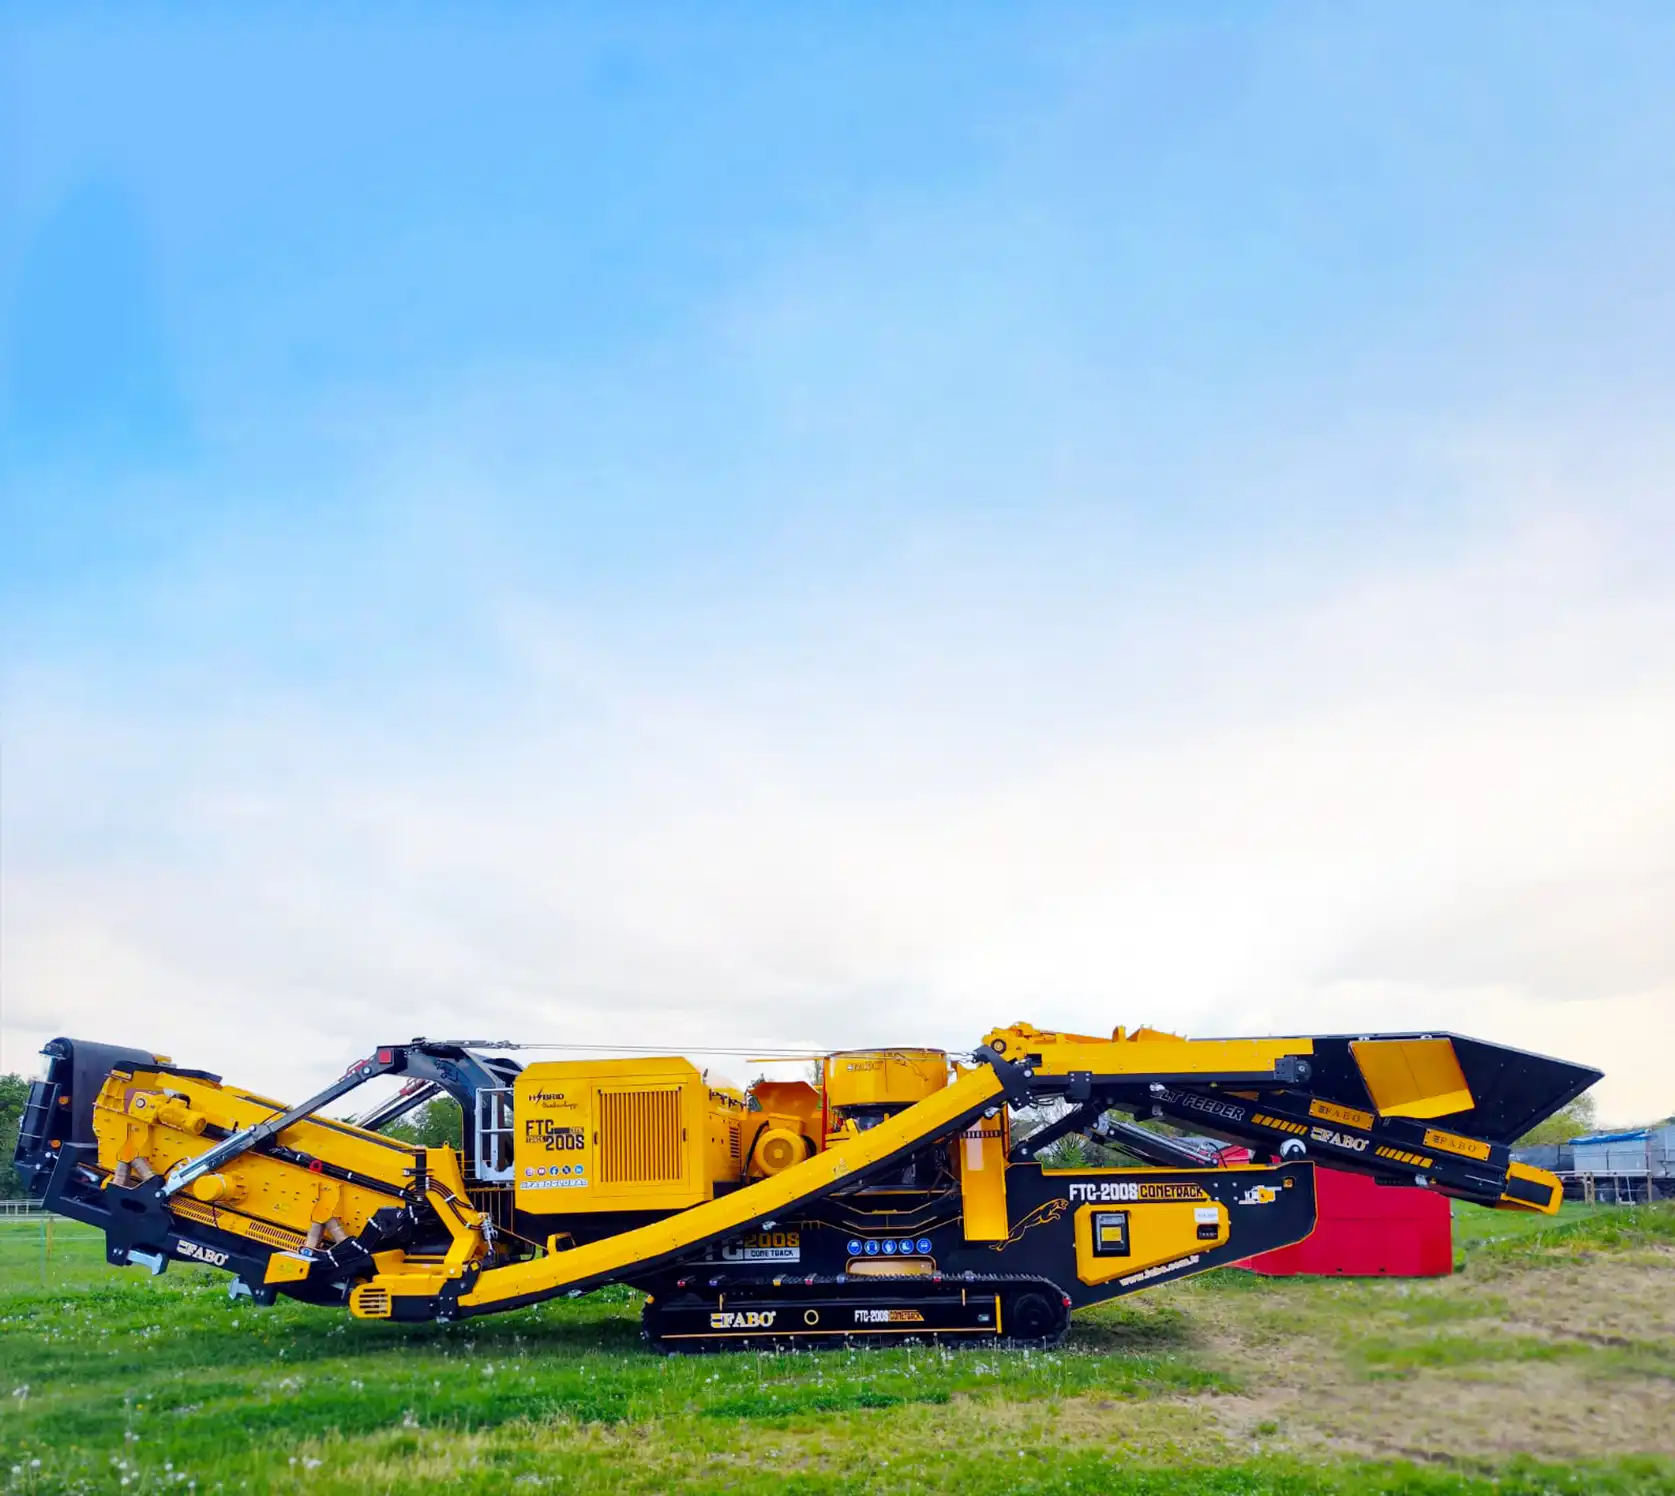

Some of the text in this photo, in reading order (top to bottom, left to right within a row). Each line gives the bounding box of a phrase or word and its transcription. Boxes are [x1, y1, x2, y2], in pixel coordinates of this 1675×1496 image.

[1182, 1093, 1246, 1121] FEEDER
[525, 1119, 555, 1135] FTC
[1310, 1126, 1370, 1152] FABO
[176, 1239, 230, 1266] FABO
[710, 1311, 777, 1328] FABO
